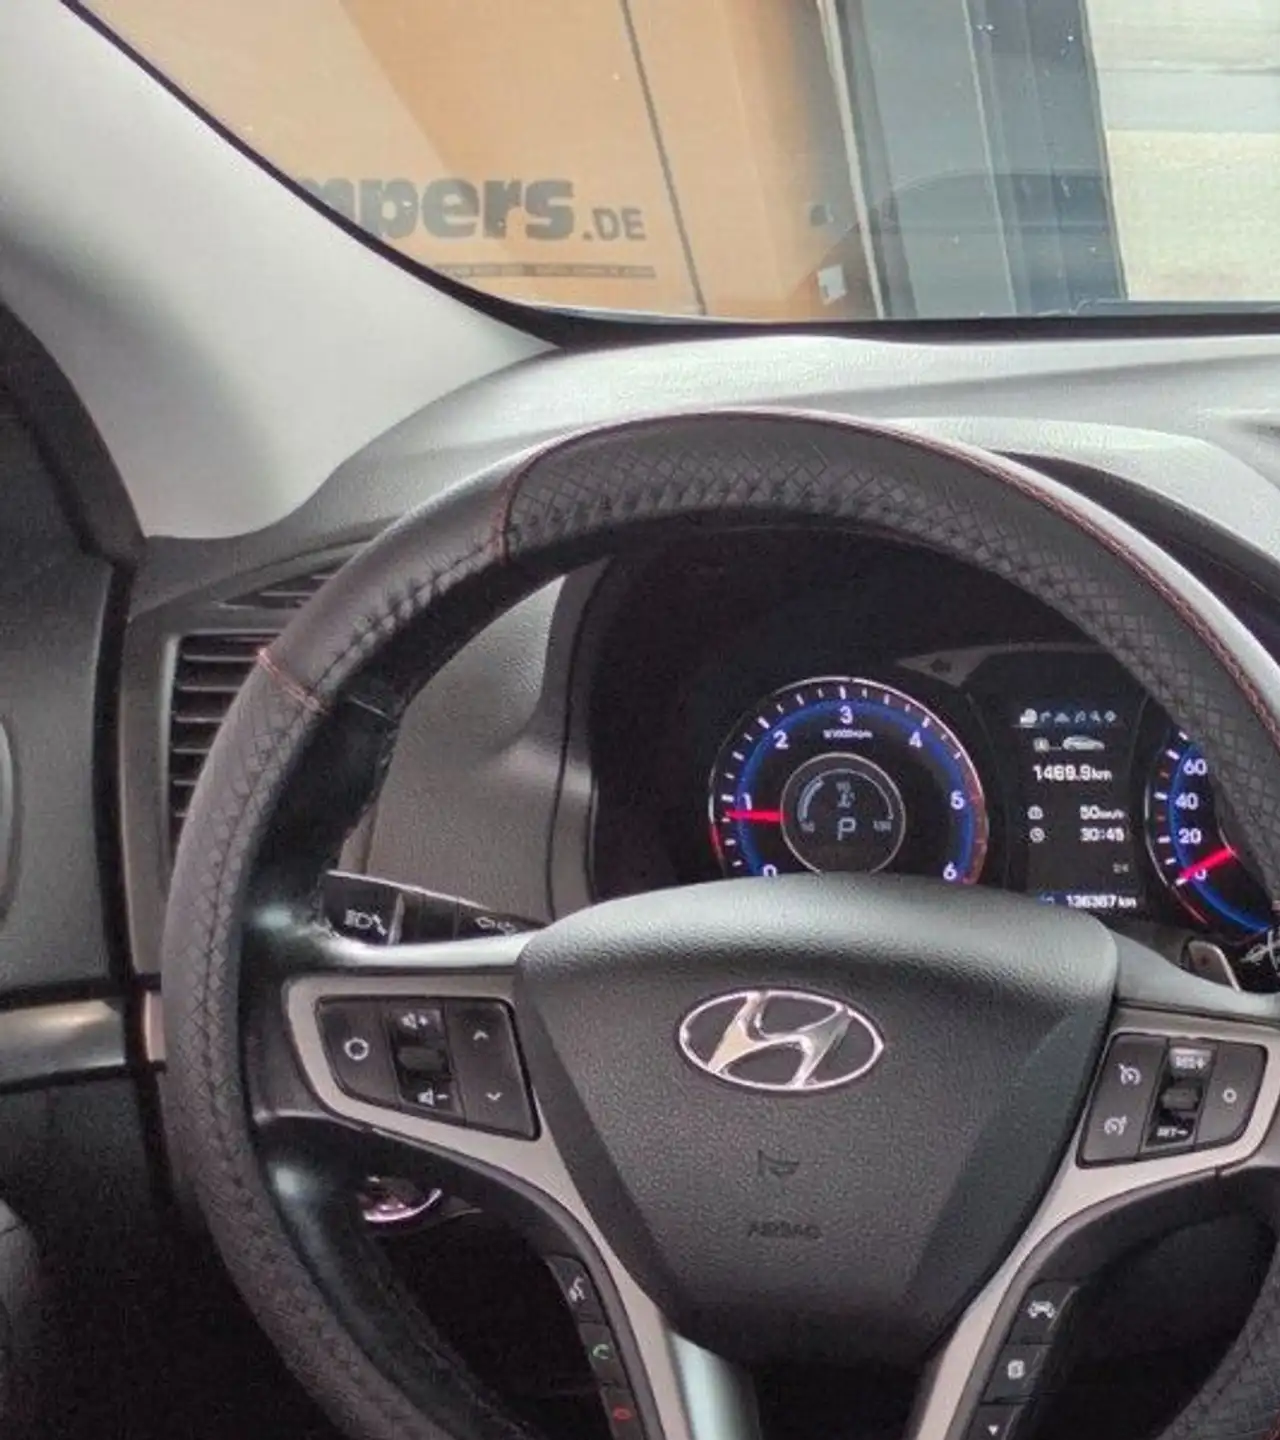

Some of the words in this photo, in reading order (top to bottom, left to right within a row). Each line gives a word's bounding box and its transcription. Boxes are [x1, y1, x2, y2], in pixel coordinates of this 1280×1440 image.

[839, 705, 854, 725] 3
[773, 729, 789, 749] 2
[908, 731, 923, 748] 4
[1183, 758, 1208, 775] 60
[743, 792, 753, 810] 1
[1174, 792, 1199, 810] 40
[837, 816, 857, 841] P
[1178, 827, 1201, 844] 20
[942, 863, 957, 881] 6
